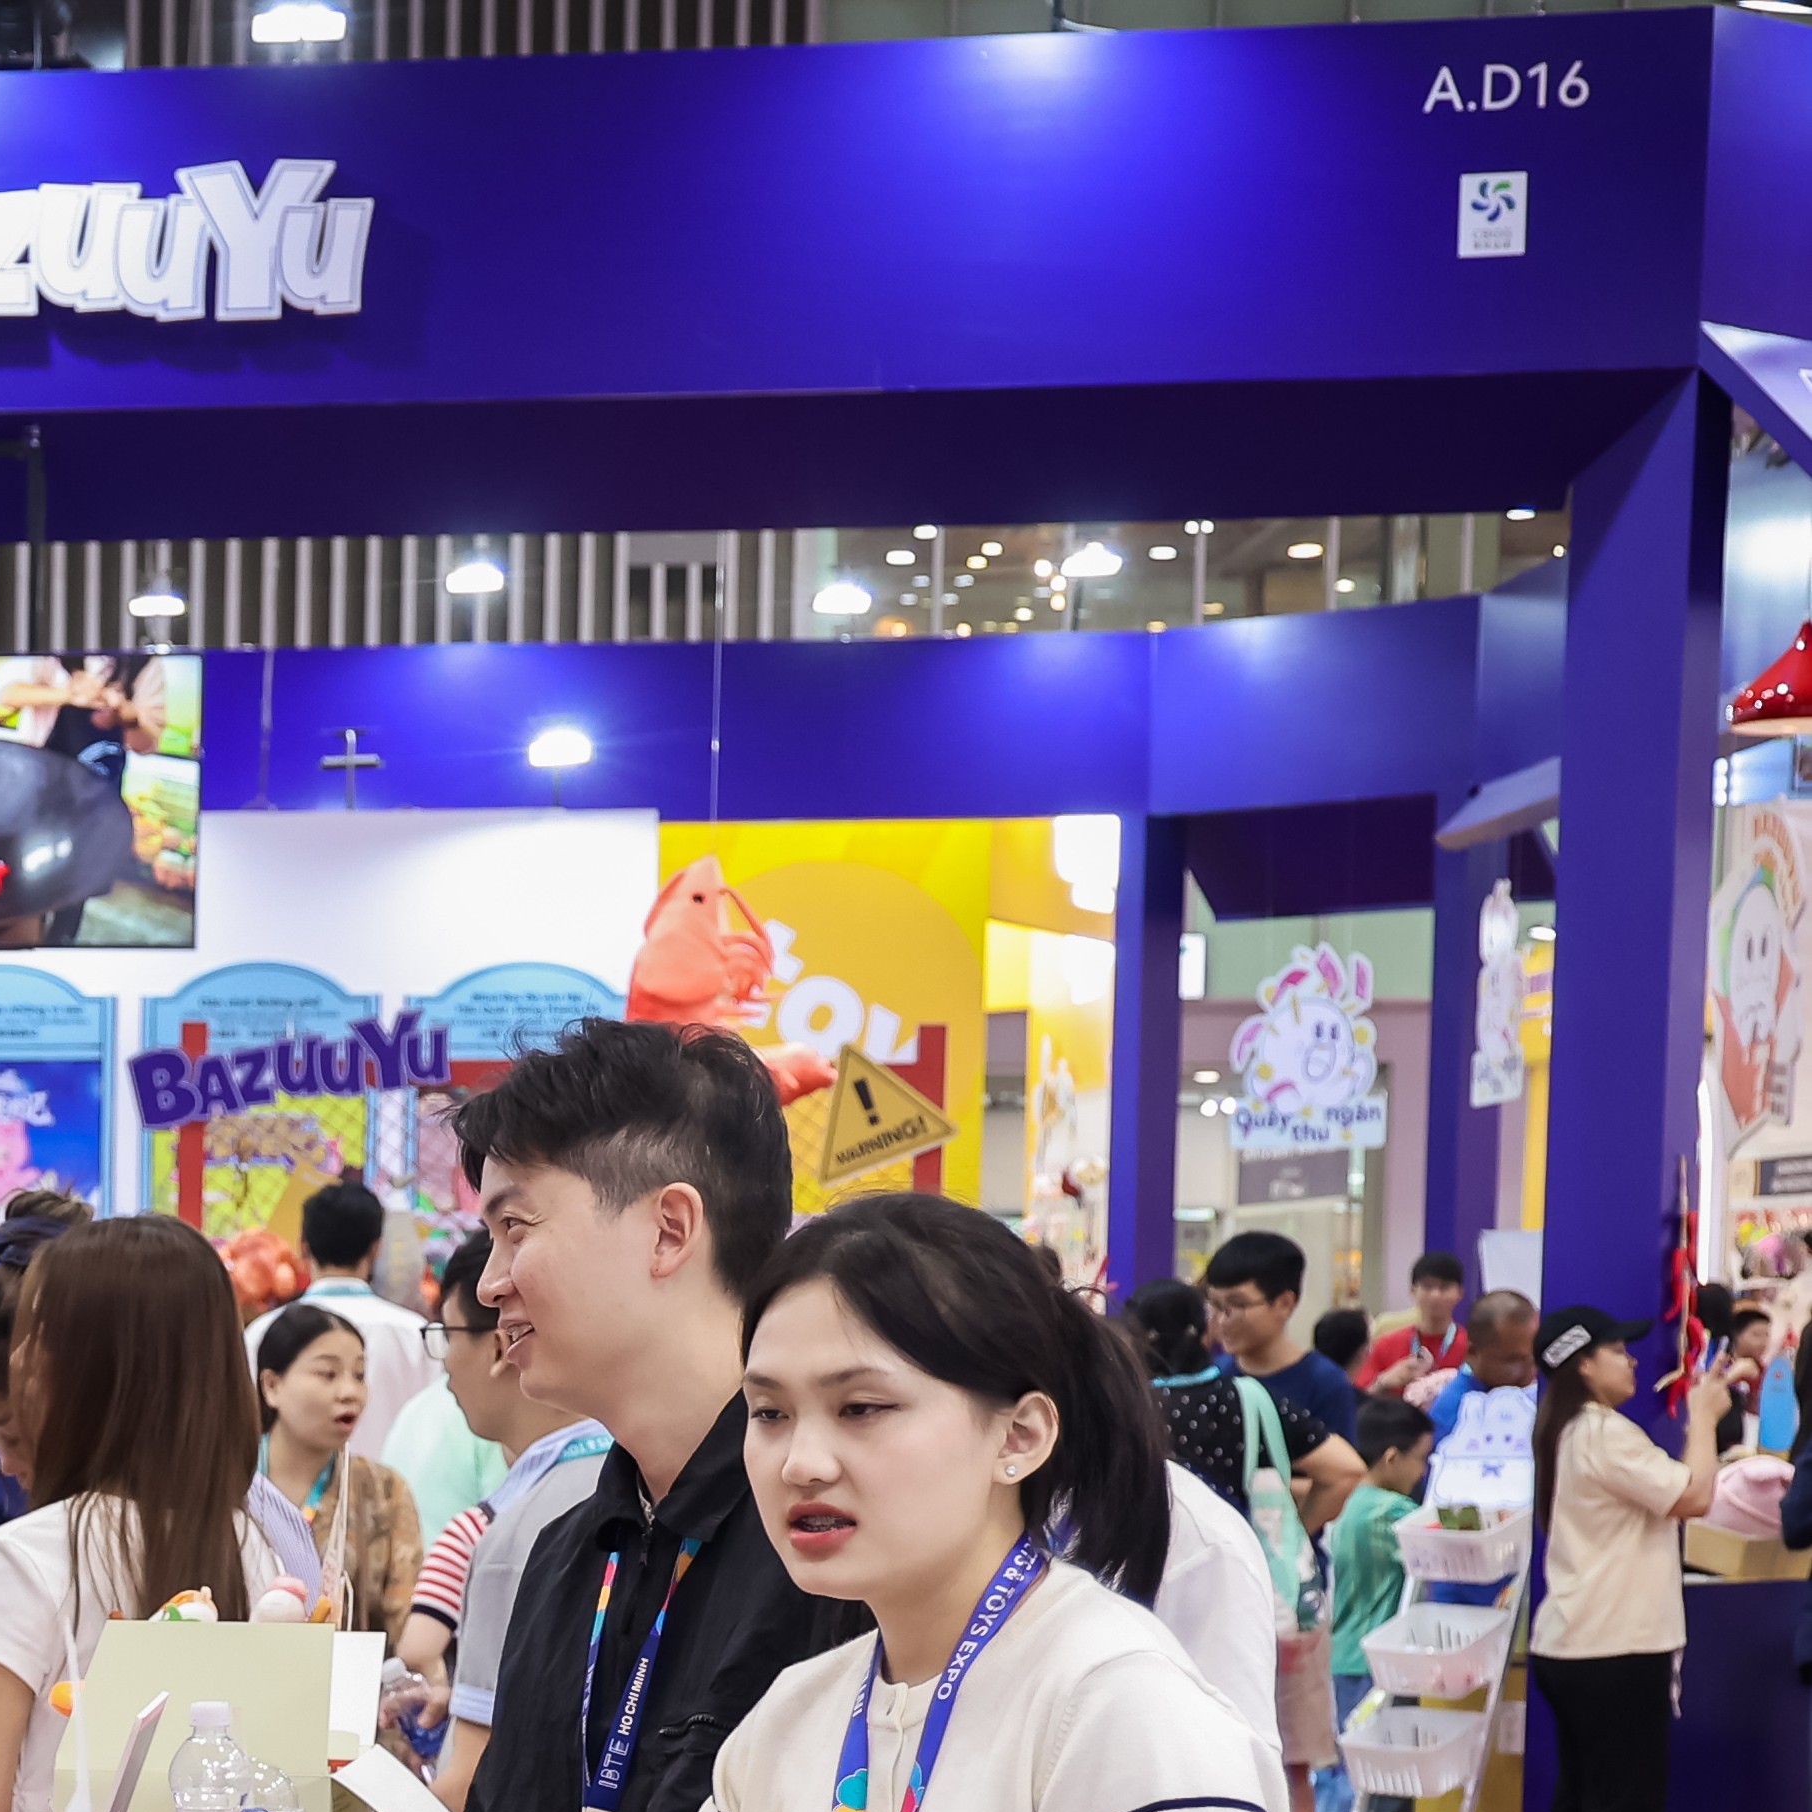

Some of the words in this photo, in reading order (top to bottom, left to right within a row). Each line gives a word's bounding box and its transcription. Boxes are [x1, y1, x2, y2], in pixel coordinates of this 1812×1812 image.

[1422, 60, 1589, 114] A.D16
[971, 1584, 1016, 1637] TOYS
[937, 1640, 978, 1701] EXPO
[598, 1738, 630, 1789] IBTE
